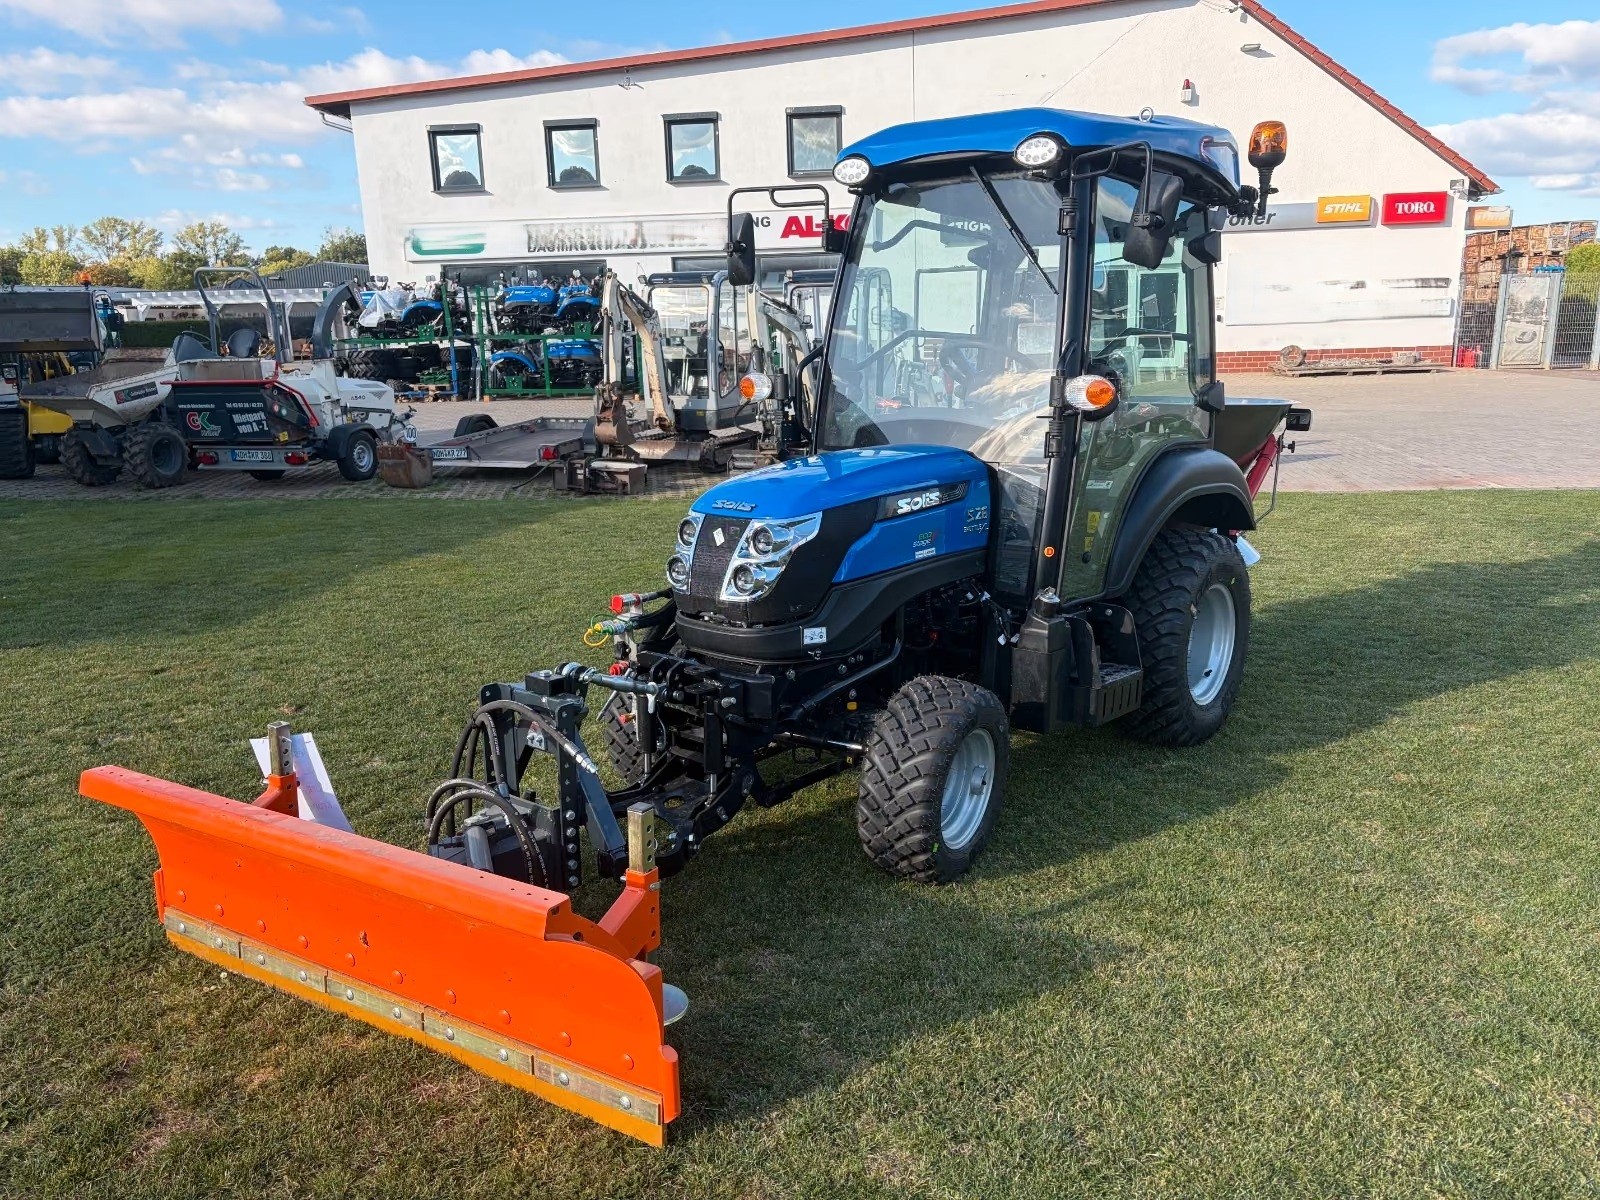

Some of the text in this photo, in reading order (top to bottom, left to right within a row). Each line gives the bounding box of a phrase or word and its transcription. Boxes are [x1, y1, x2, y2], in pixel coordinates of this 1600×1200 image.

[1323, 203, 1365, 214] STIHL
[1395, 201, 1436, 215] TORO
[405, 427, 417, 439] 100
